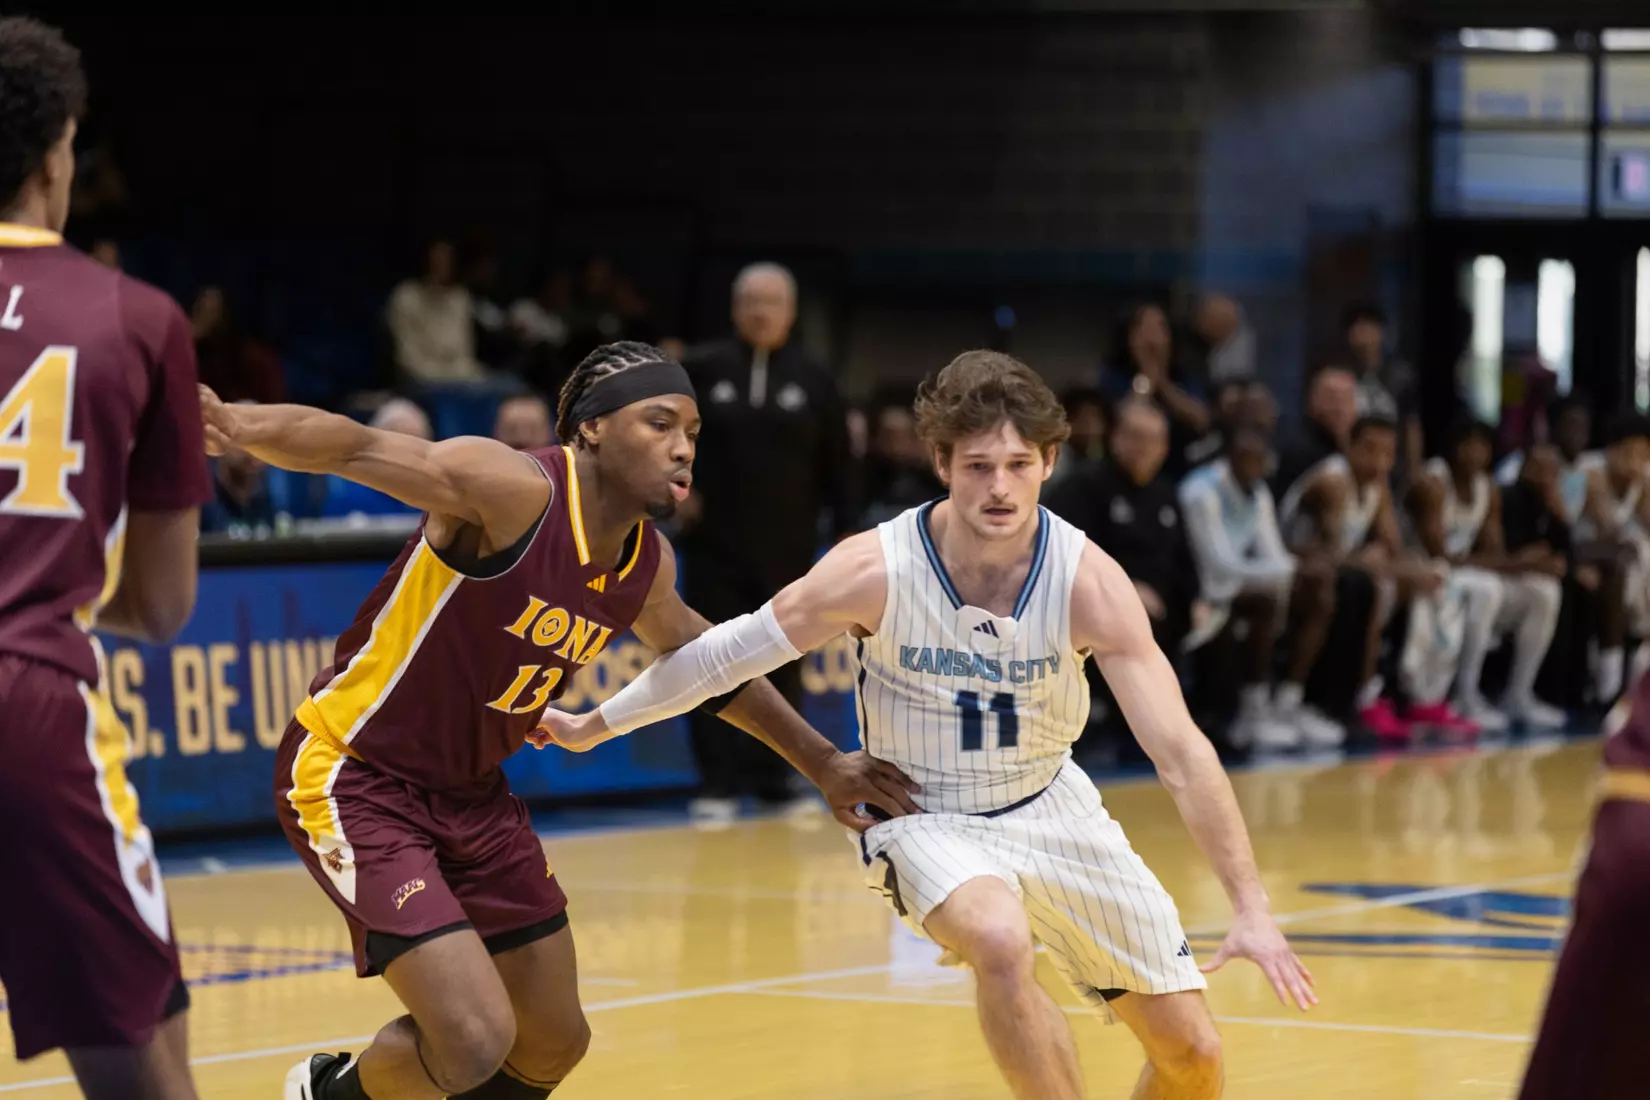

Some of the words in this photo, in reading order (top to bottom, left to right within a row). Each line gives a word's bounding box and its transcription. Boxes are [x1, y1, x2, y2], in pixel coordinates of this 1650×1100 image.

[503, 594, 613, 665] IONA
[485, 664, 563, 714] 13
[900, 645, 1002, 682] KANSAS
[1008, 651, 1061, 684] CITY
[105, 647, 166, 759] S.
[171, 642, 246, 757] BE
[955, 690, 1019, 752] 11
